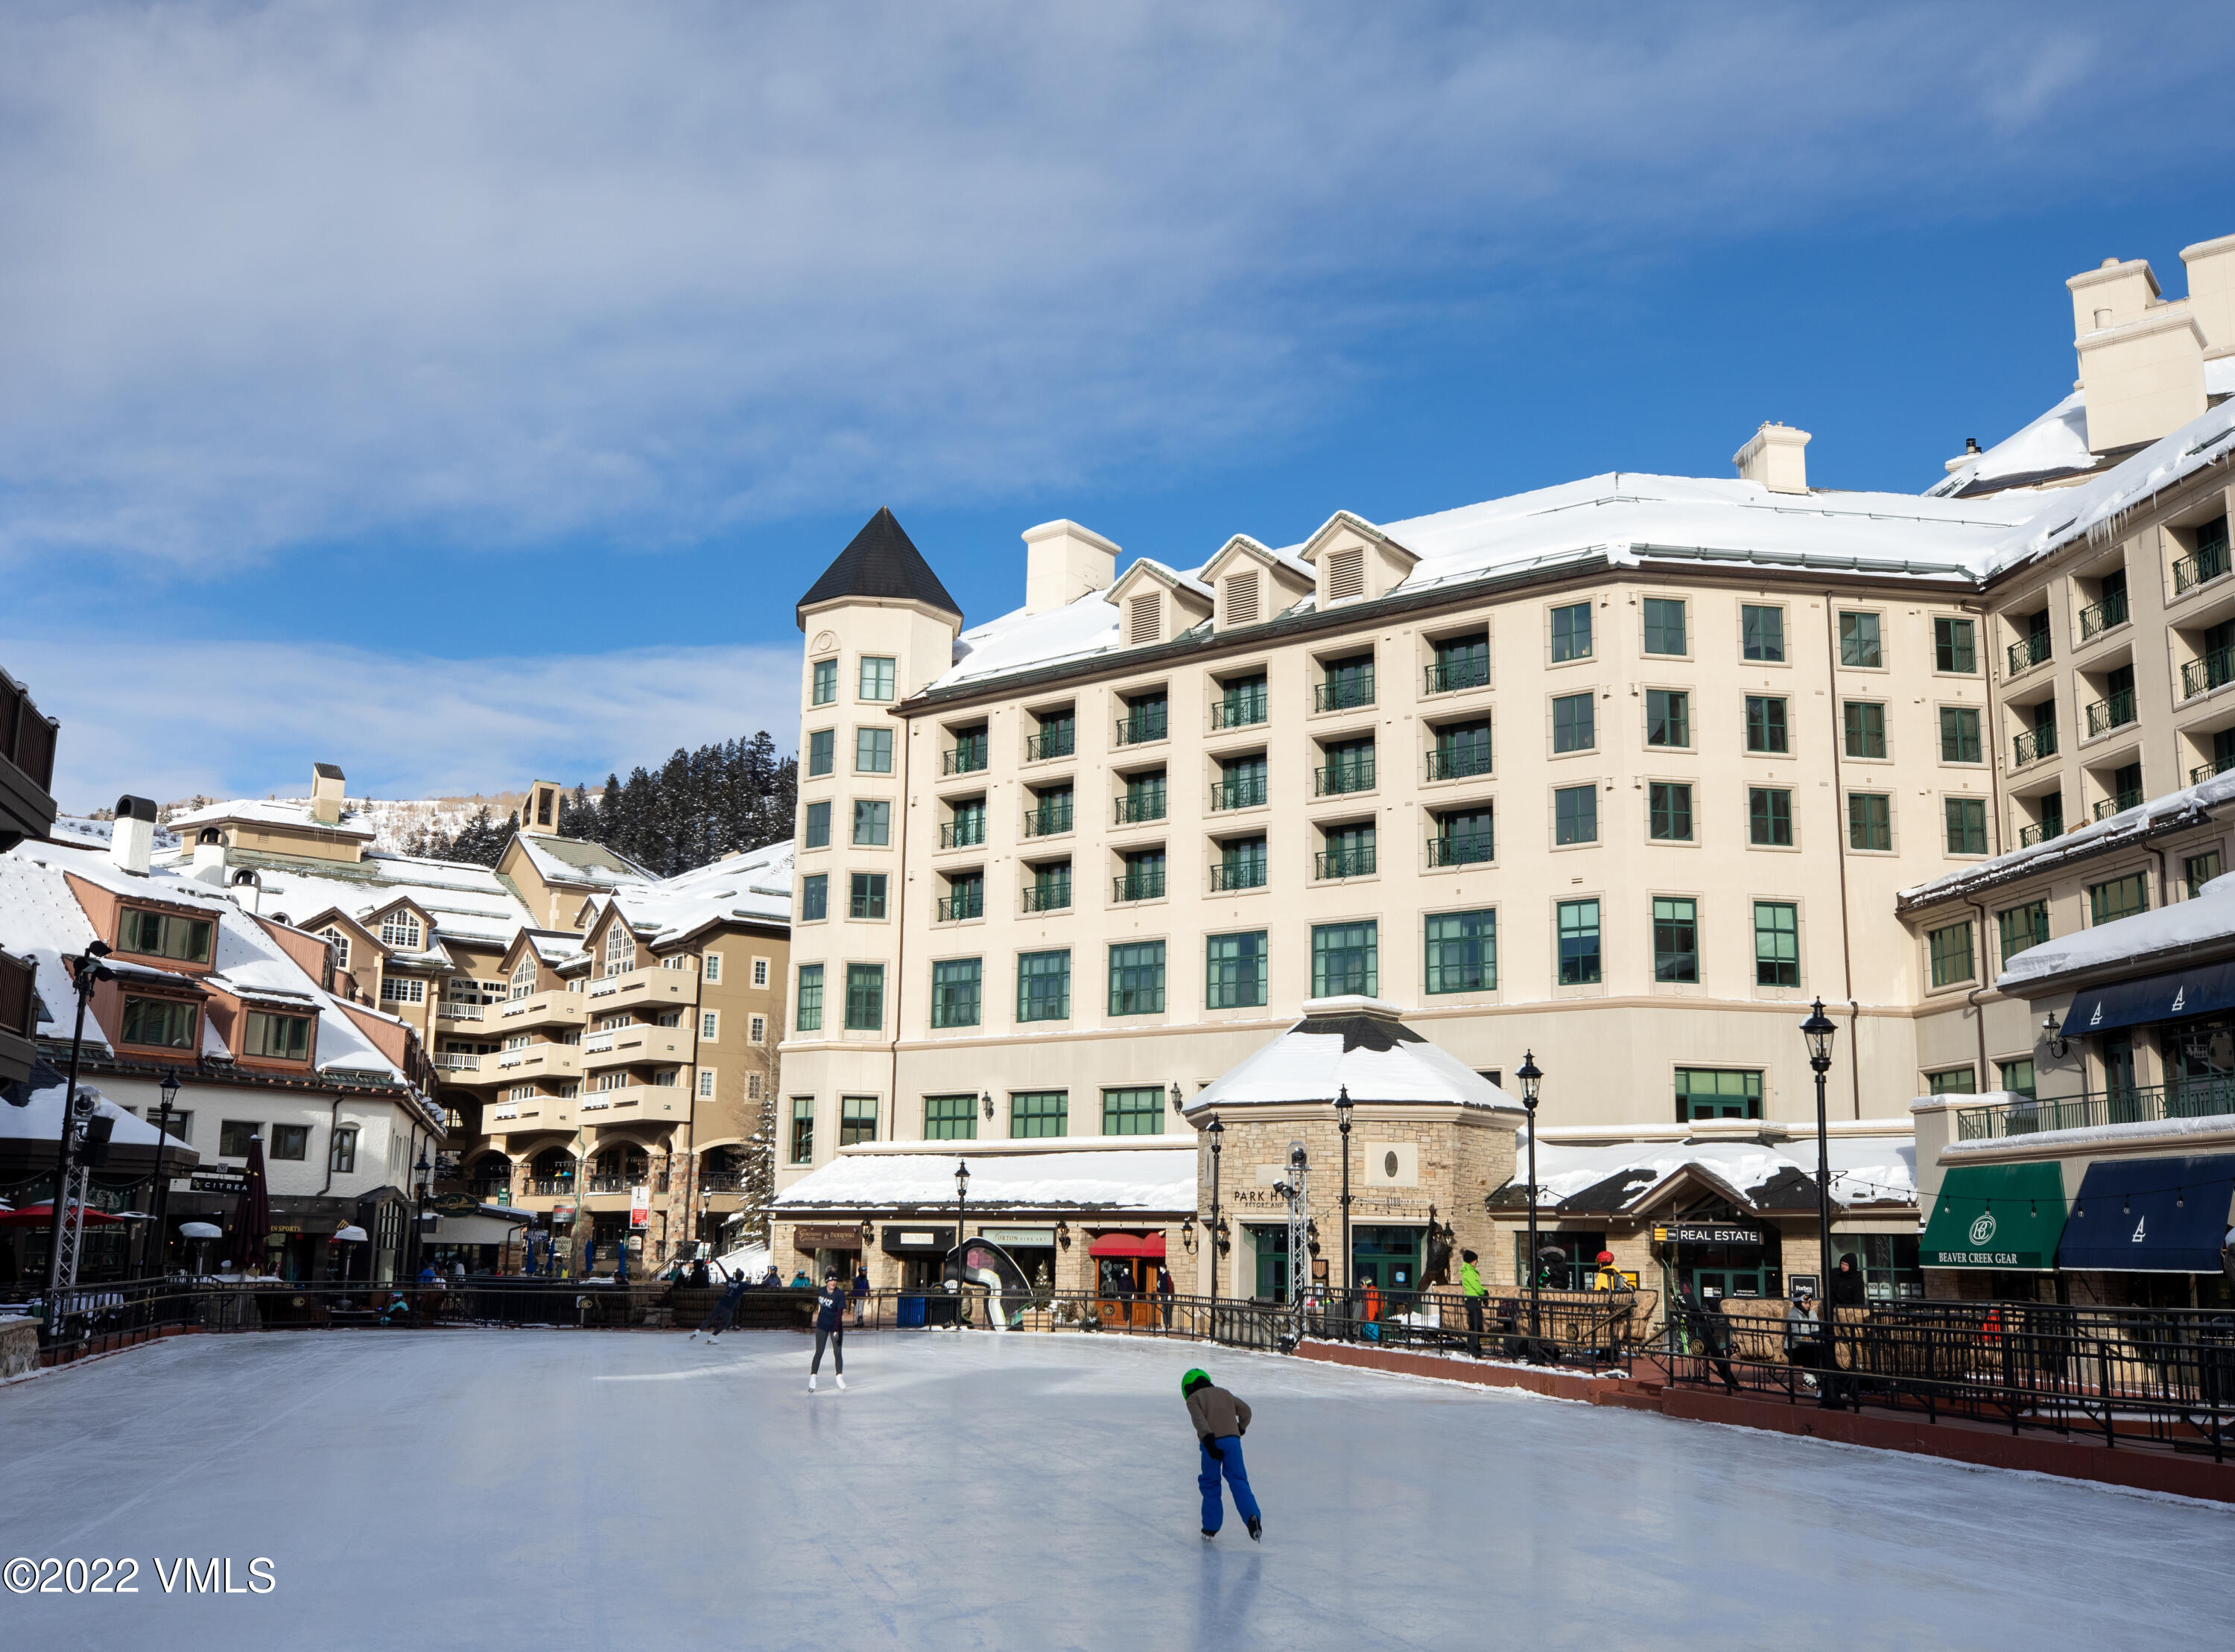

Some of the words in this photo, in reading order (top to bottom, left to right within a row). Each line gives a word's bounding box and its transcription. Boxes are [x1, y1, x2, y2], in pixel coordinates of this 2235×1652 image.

[205, 1181, 248, 1191] CITREA
[1234, 1191, 1264, 1201] PARK
[1680, 1230, 1711, 1240] REAL
[1714, 1230, 1758, 1242] ESTATE
[1938, 1252, 1967, 1262] BEAVER
[1968, 1253, 1993, 1263] CREEK
[1995, 1253, 2017, 1264] GEAR
